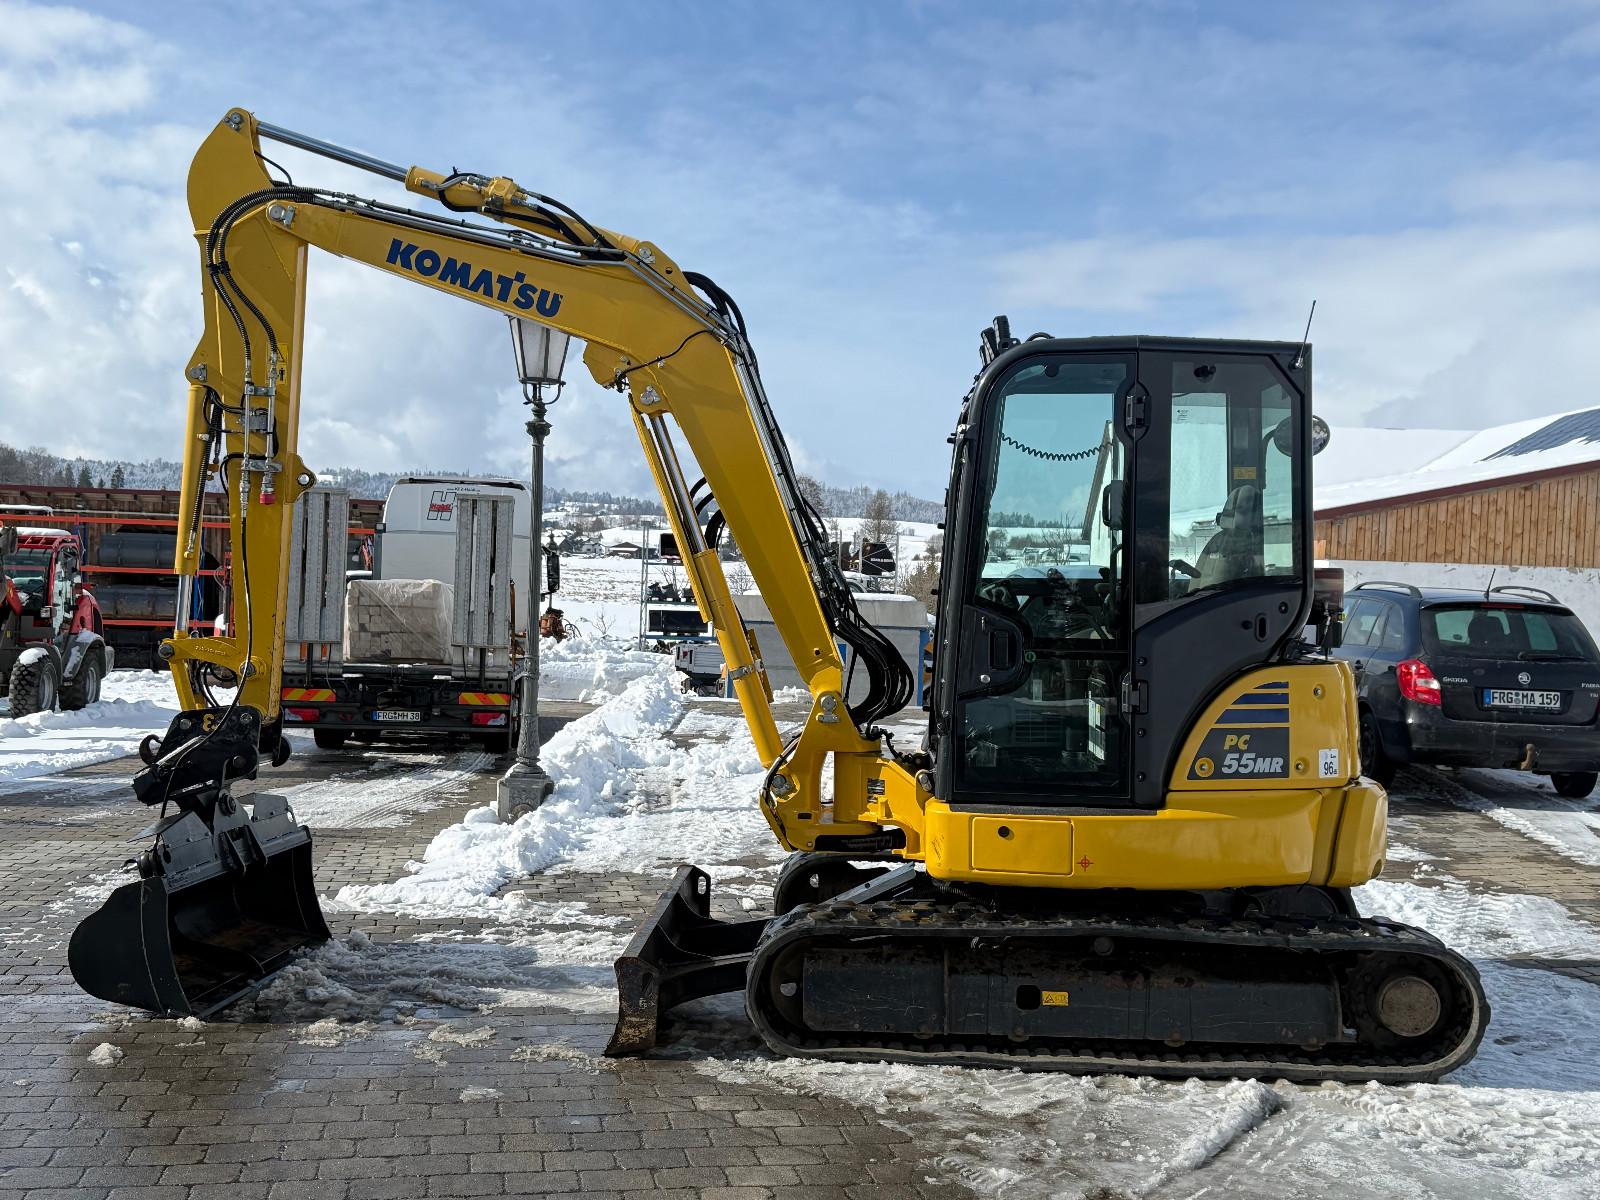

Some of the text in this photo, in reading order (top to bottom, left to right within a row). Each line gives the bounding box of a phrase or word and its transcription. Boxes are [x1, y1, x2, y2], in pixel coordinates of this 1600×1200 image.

[386, 238, 563, 318] KOMATSU
[1491, 691, 1560, 706] FRG MA 159
[377, 711, 393, 720] FRG
[1223, 734, 1251, 750] PC
[1221, 752, 1284, 774] 55MR
[1323, 761, 1334, 776] 96
